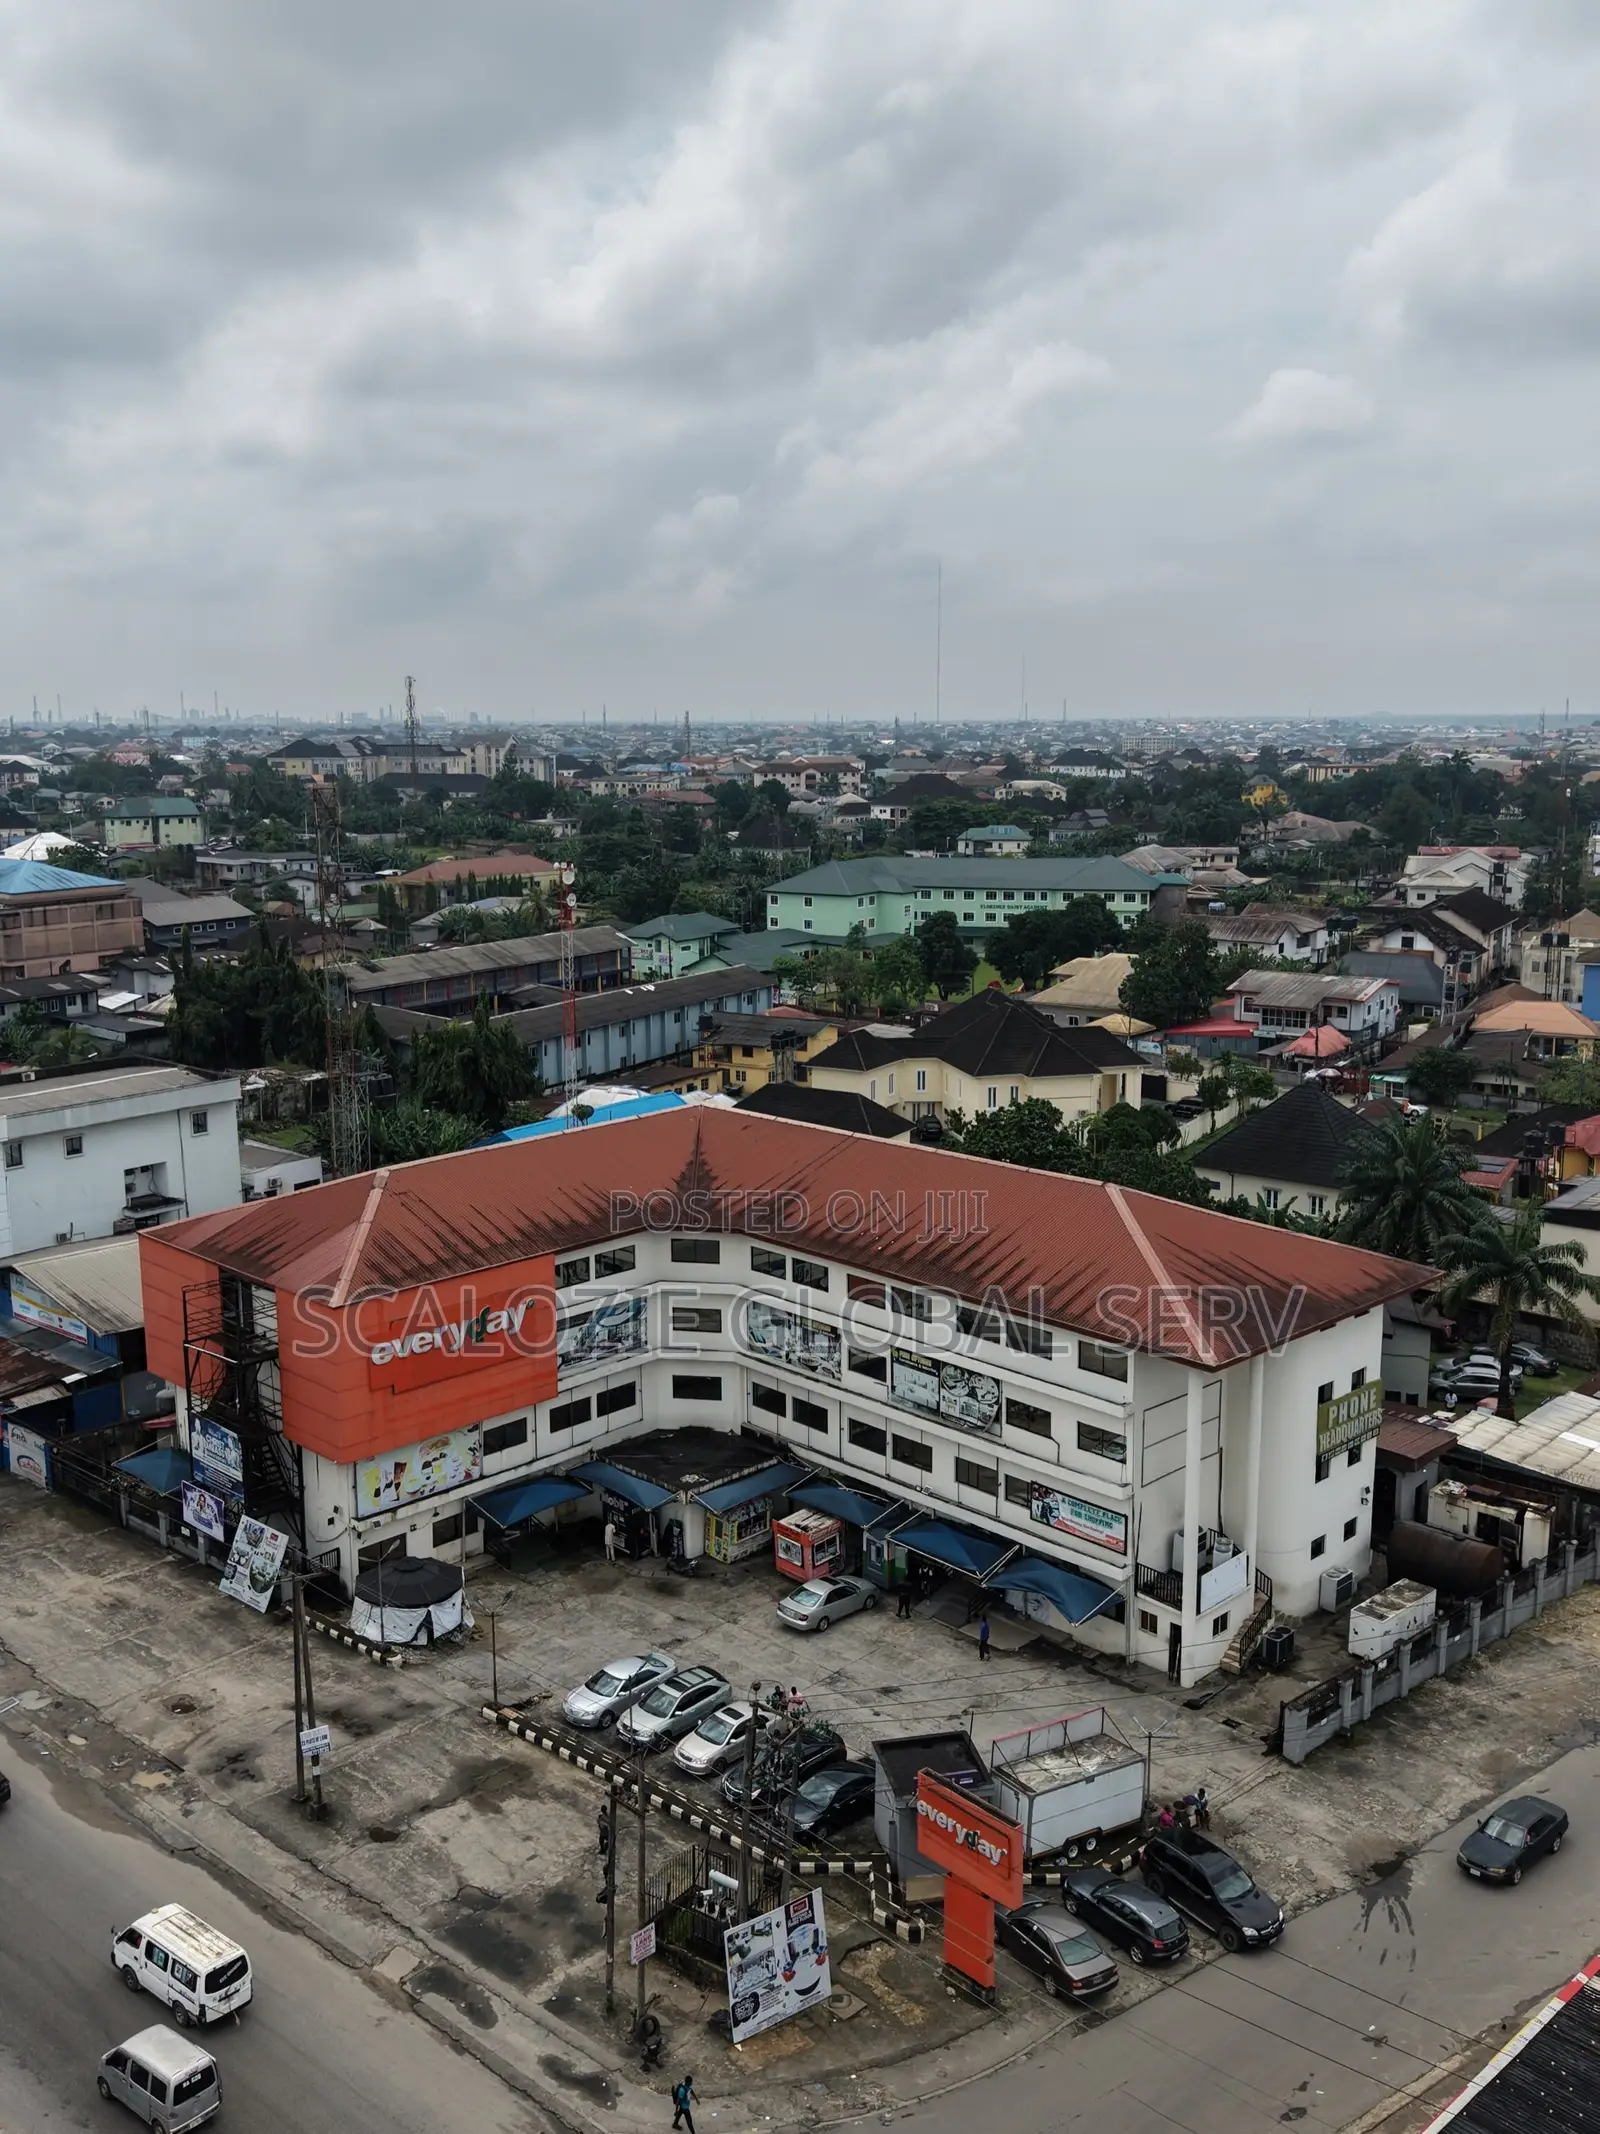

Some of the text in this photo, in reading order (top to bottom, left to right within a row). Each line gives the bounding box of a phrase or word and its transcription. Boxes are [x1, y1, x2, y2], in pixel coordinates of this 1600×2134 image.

[371, 1300, 531, 1365] everyday
[1328, 1388, 1377, 1429] PHONE
[1320, 1408, 1385, 1452] HEADQUARTERS
[1068, 1499, 1101, 1517] COMPLETE
[1102, 1511, 1122, 1524] PLACE
[1071, 1509, 1082, 1518] FOR
[1085, 1513, 1113, 1529] SHOPPING
[917, 1800, 1001, 1866] everyday
